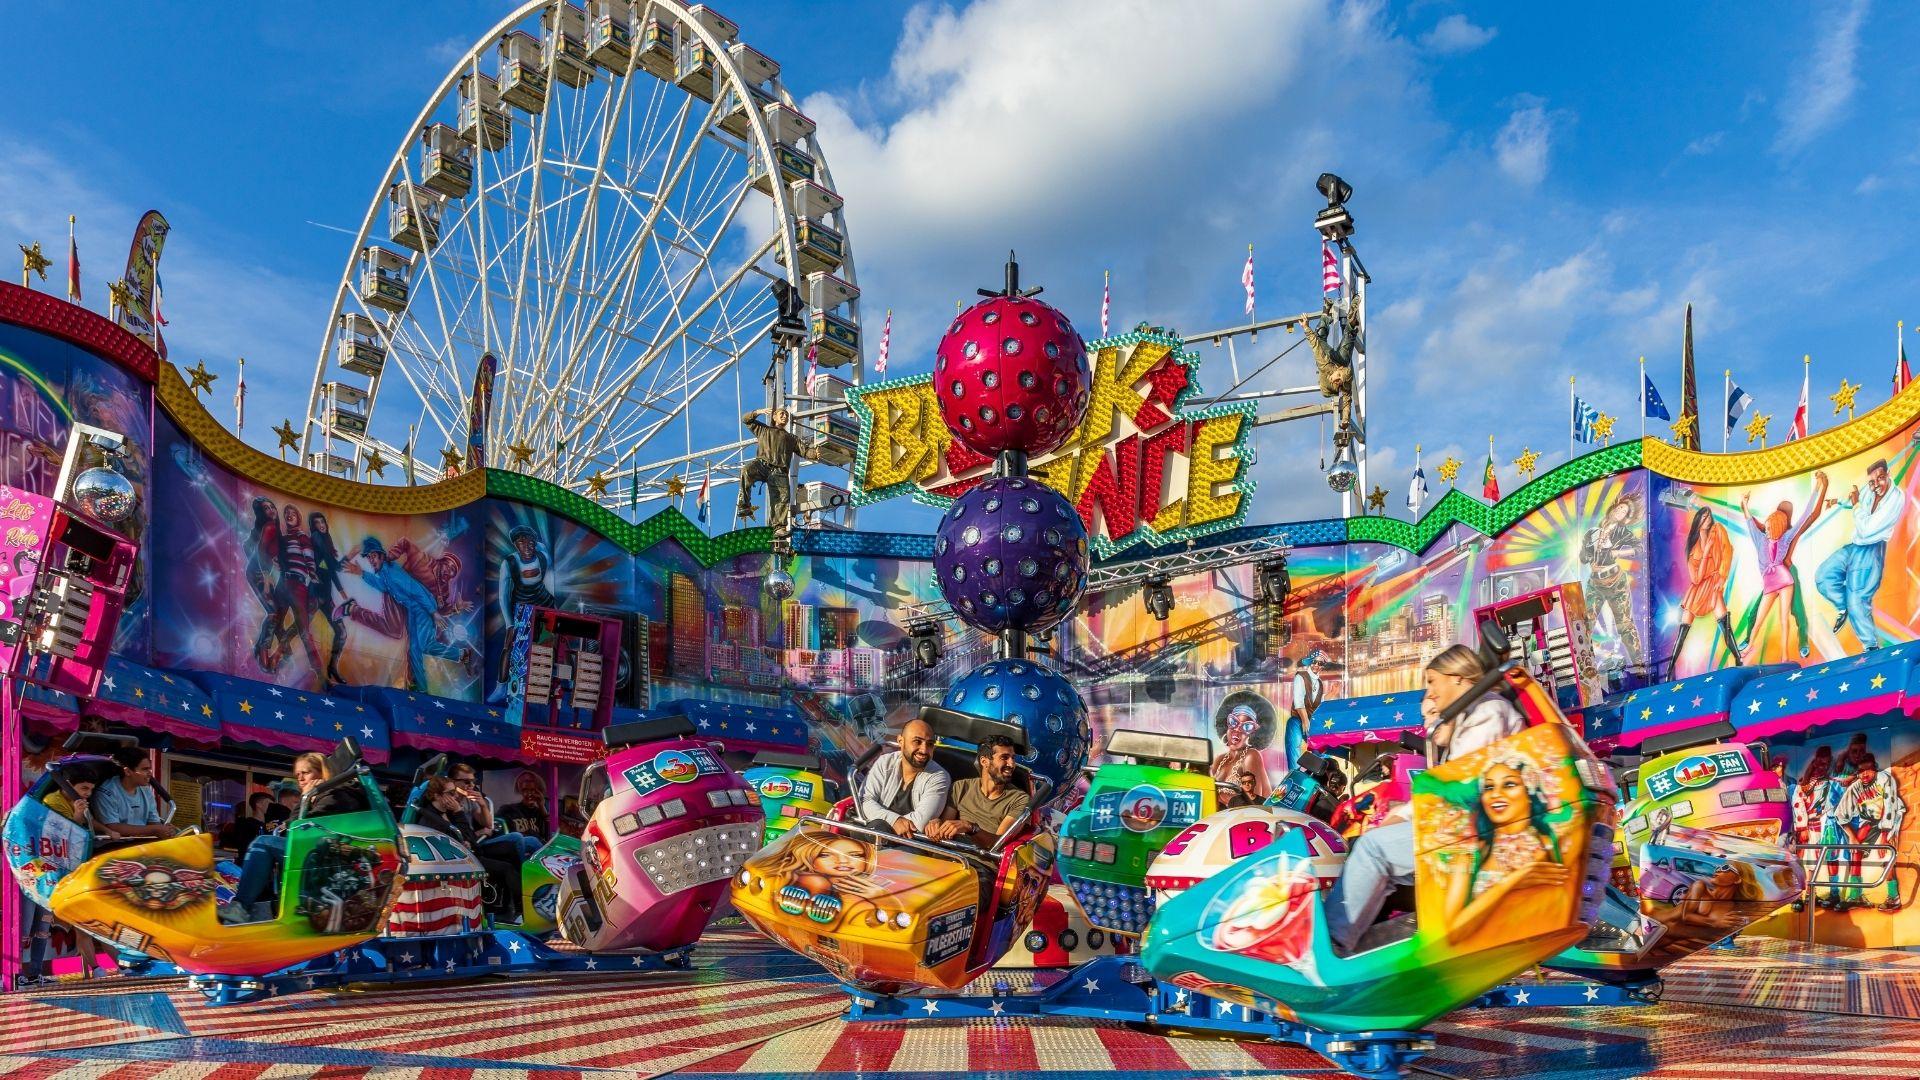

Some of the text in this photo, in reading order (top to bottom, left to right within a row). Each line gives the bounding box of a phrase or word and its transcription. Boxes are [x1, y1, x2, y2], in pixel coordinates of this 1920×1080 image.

[5, 527, 39, 549] Ride
[536, 734, 563, 743] RAUCHEN
[563, 738, 592, 747] VERBOTEN
[667, 758, 688, 775] 3
[696, 755, 716, 767] FAN
[1720, 758, 1740, 769] FAN
[1682, 761, 1711, 781] 11
[795, 785, 810, 795] FAN
[1173, 791, 1195, 800] Dance
[1133, 797, 1153, 820] 6
[1172, 802, 1196, 817] FAN
